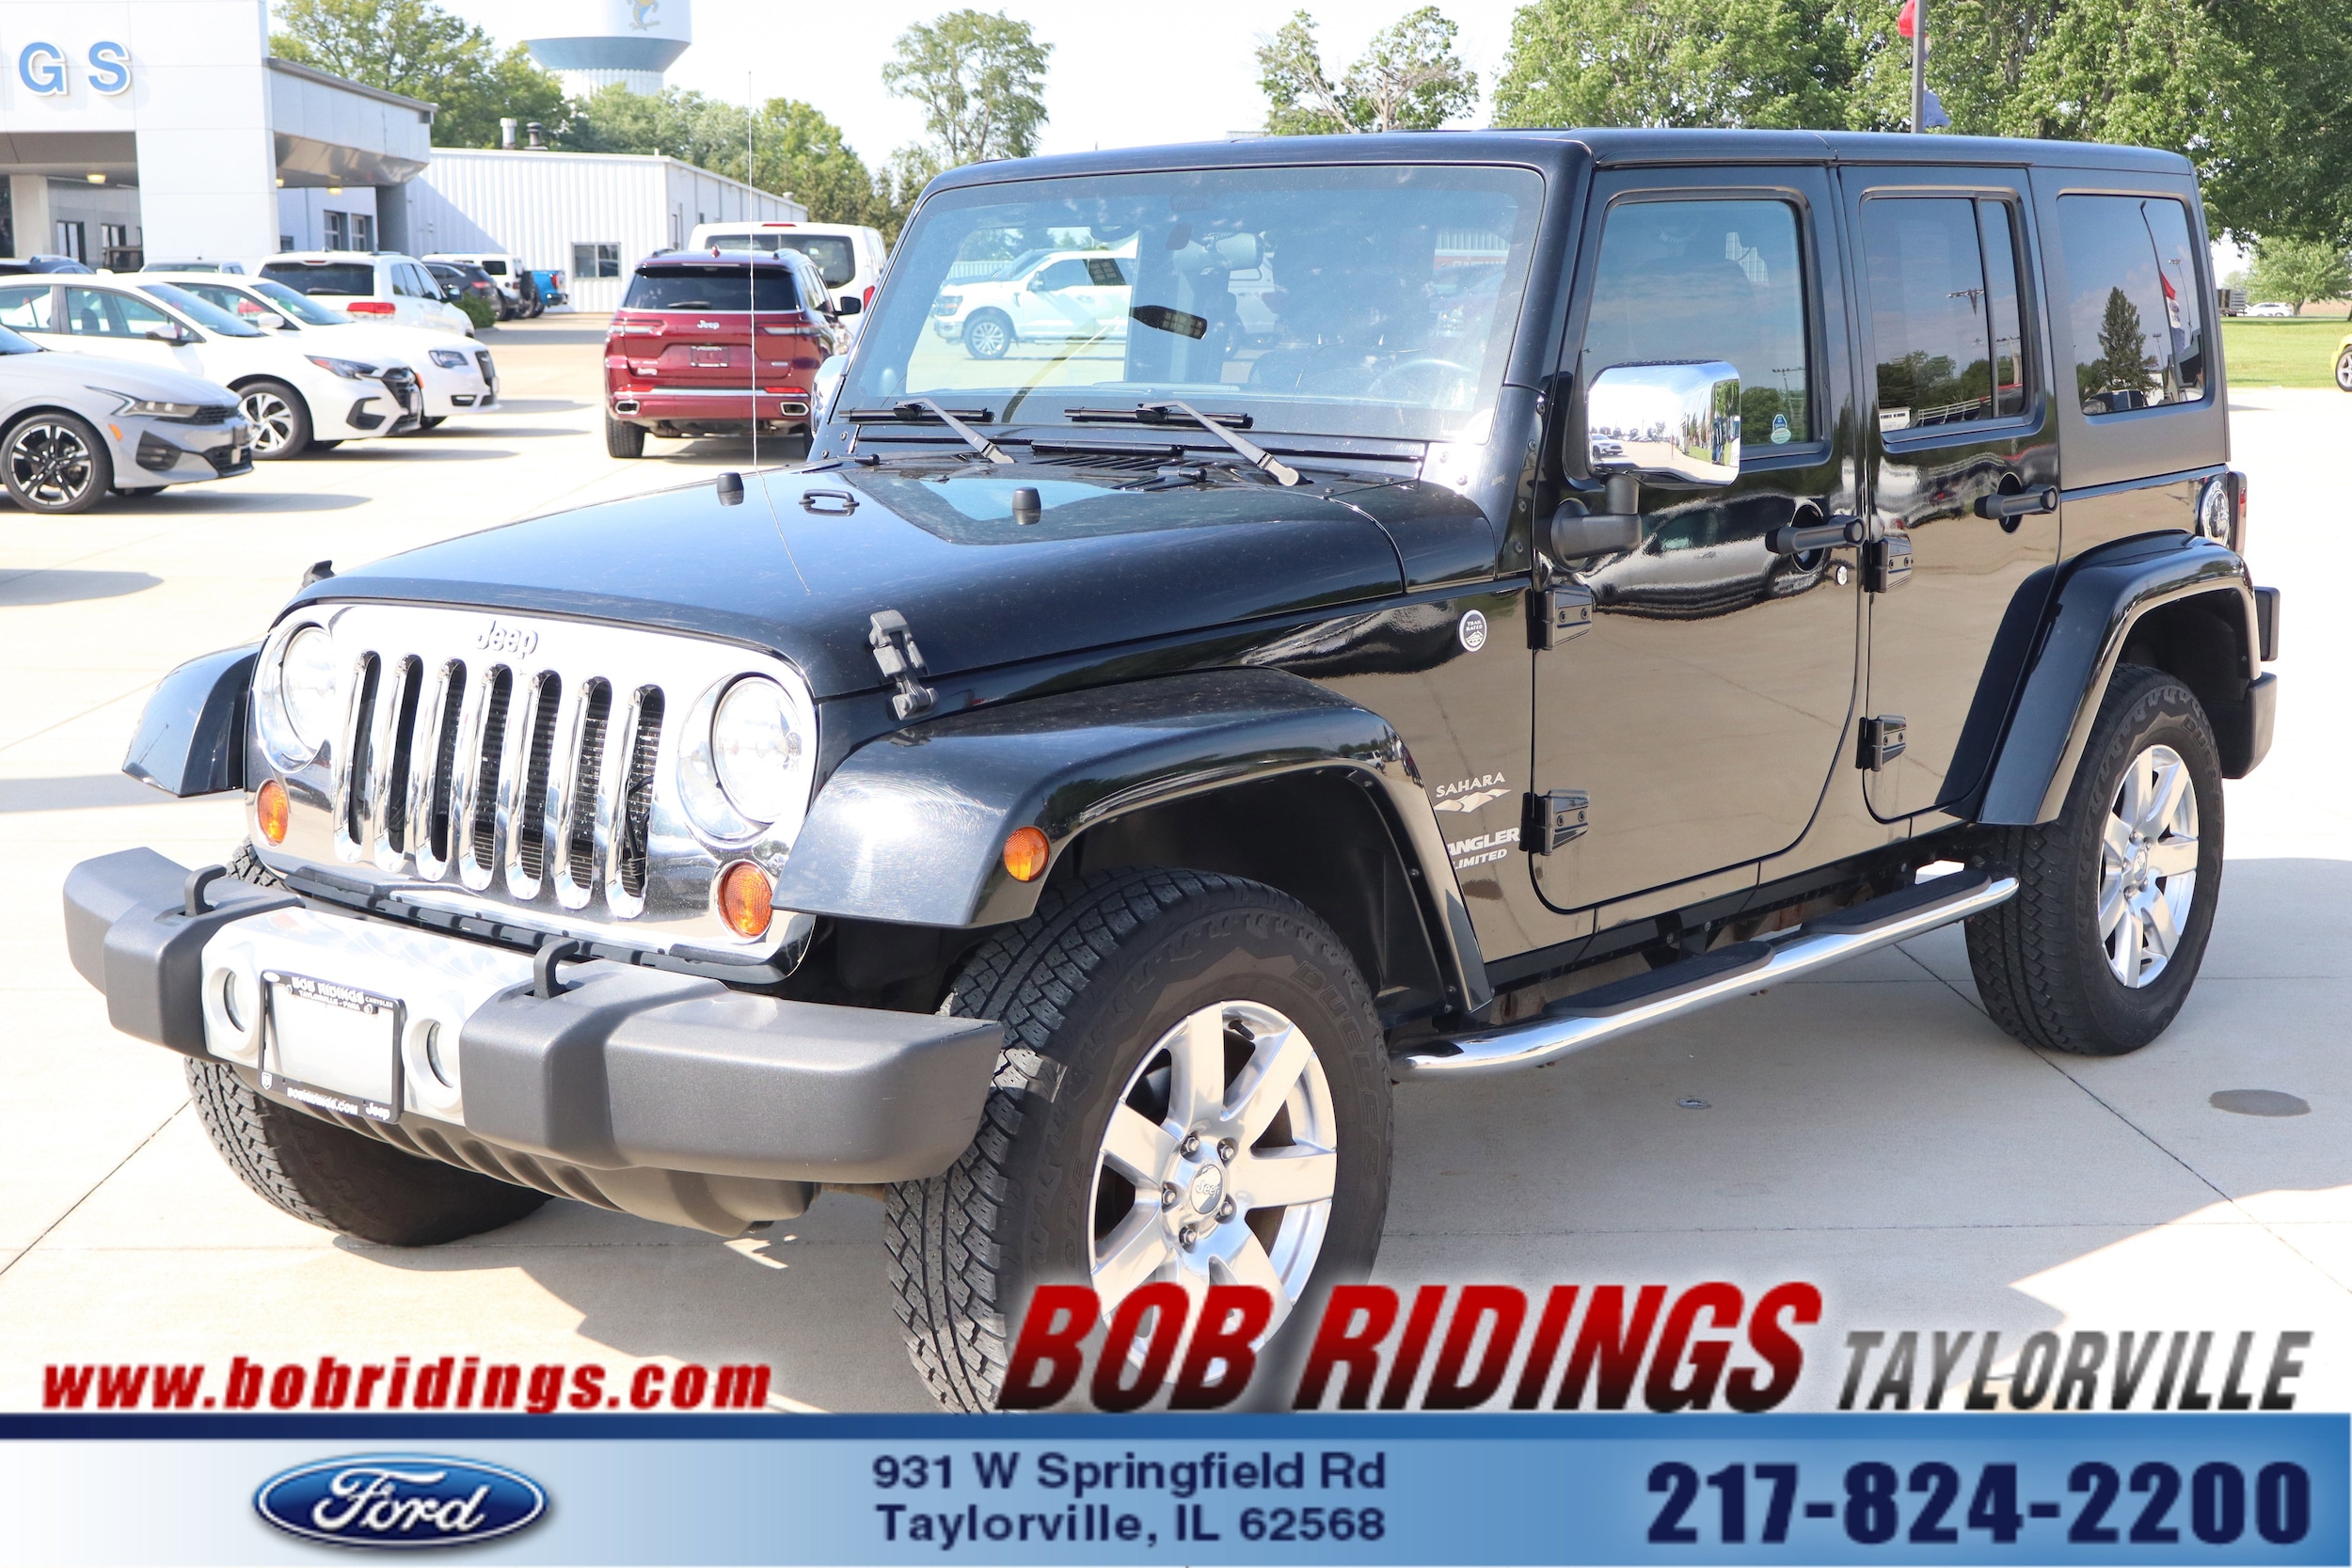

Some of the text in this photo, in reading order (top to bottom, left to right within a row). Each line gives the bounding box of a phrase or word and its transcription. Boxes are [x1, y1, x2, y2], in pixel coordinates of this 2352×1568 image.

[696, 319, 721, 330] Jeep
[476, 619, 539, 660] Jeep
[1436, 771, 1506, 799] SAHARA
[292, 976, 366, 1006] BOB RIDINGS
[364, 996, 394, 1009] CHRYSLER
[365, 1101, 391, 1121] Jeep
[1196, 1180, 1221, 1198] Jeep
